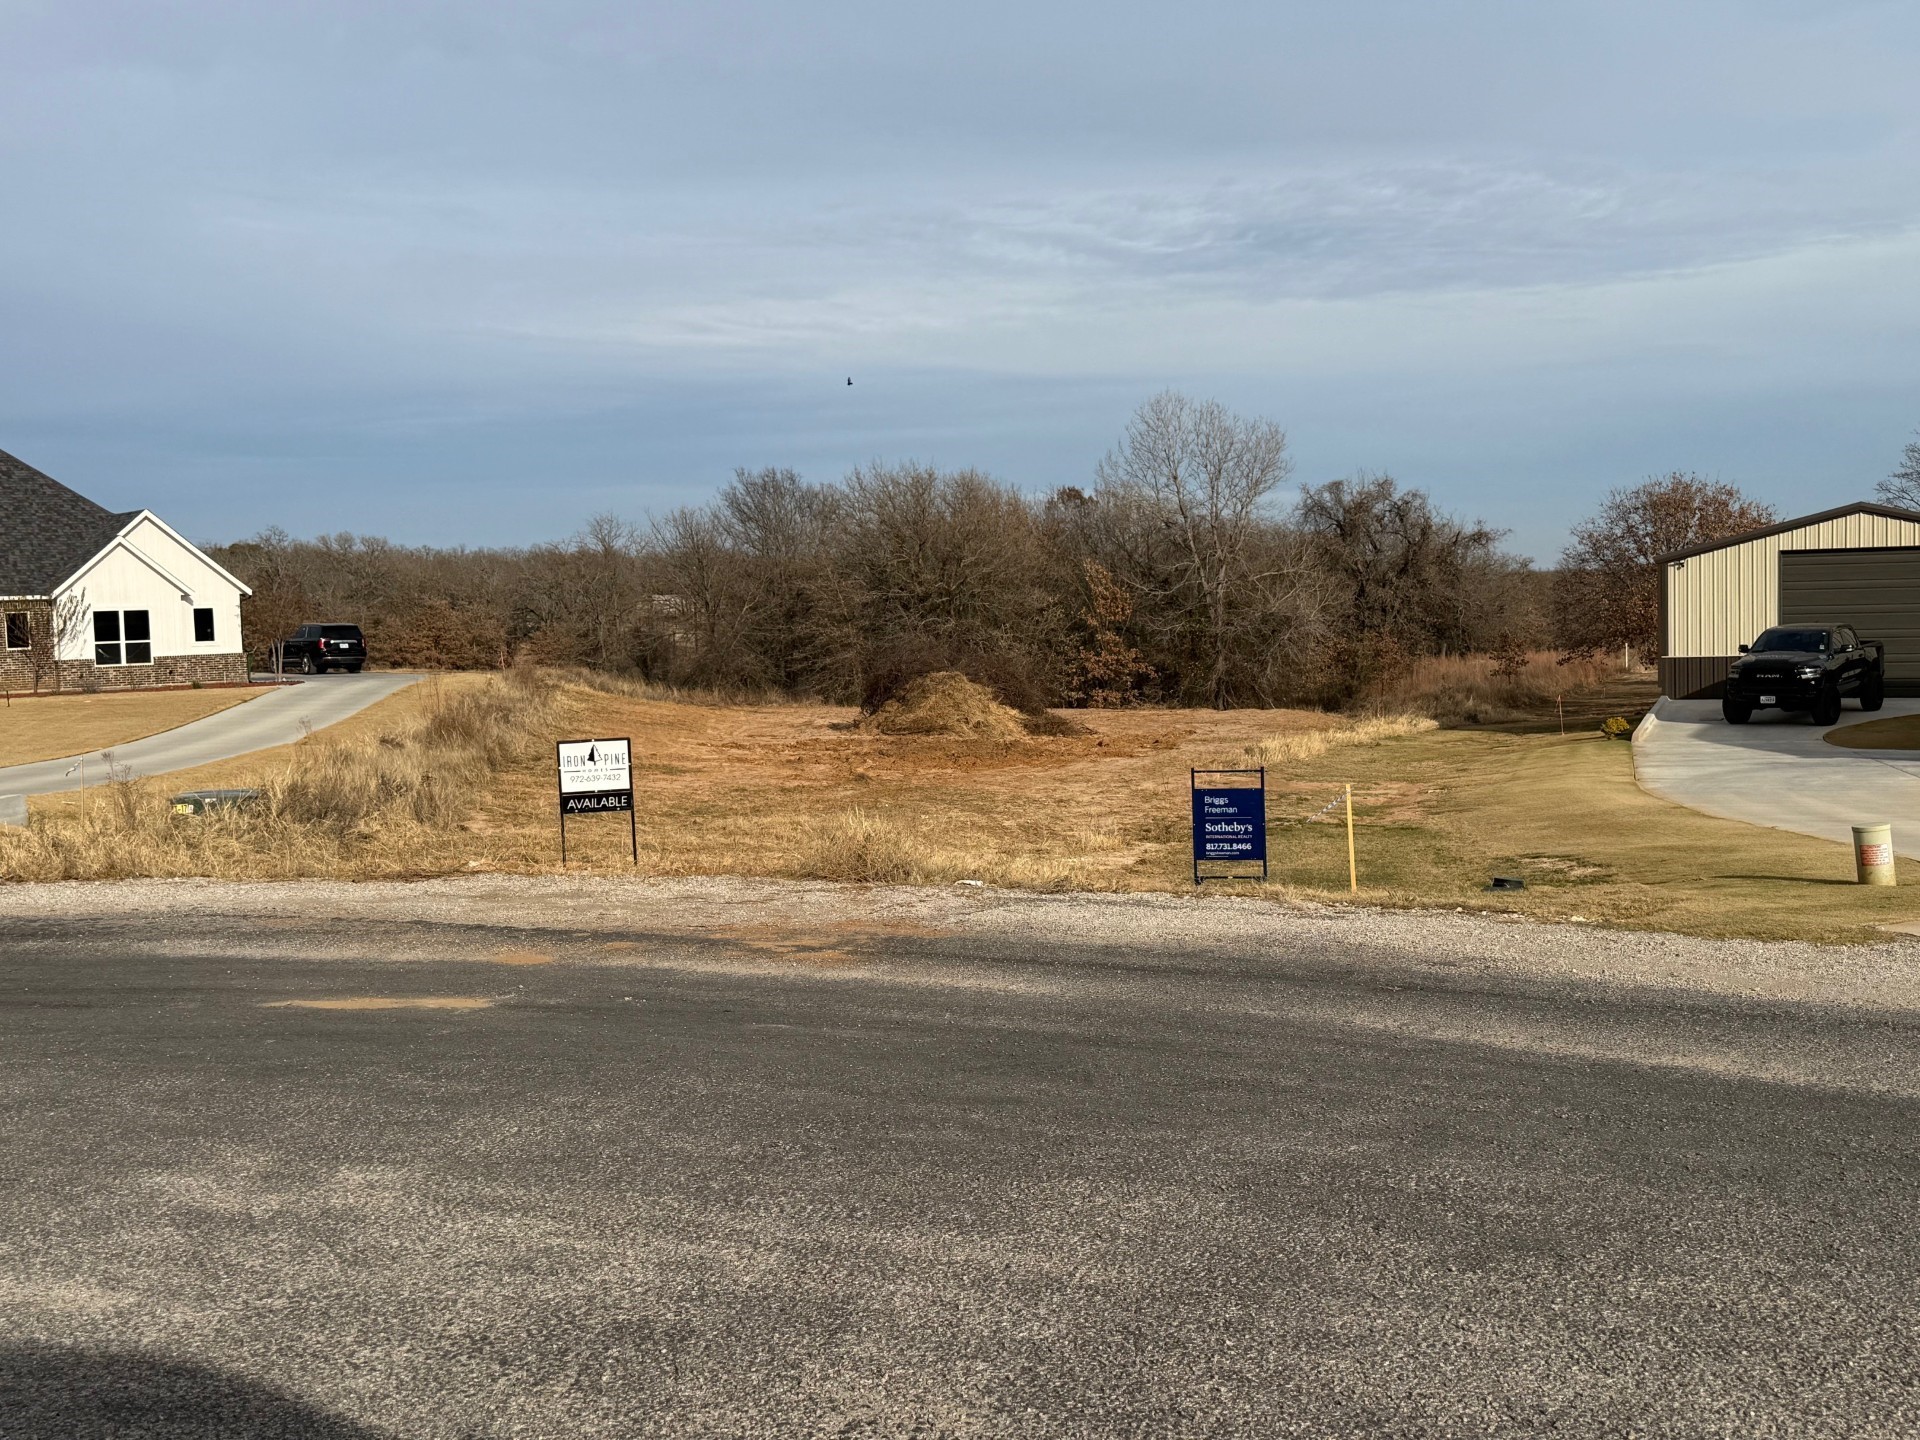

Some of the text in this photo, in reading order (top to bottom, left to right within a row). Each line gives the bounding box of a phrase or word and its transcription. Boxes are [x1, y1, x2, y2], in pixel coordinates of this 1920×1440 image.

[563, 753, 626, 767] IRON PINE
[570, 773, 621, 783] 972-639-7432
[567, 796, 628, 809] AVAILABLE
[1204, 796, 1229, 805] Briggs
[1205, 822, 1253, 834] Sotheby's
